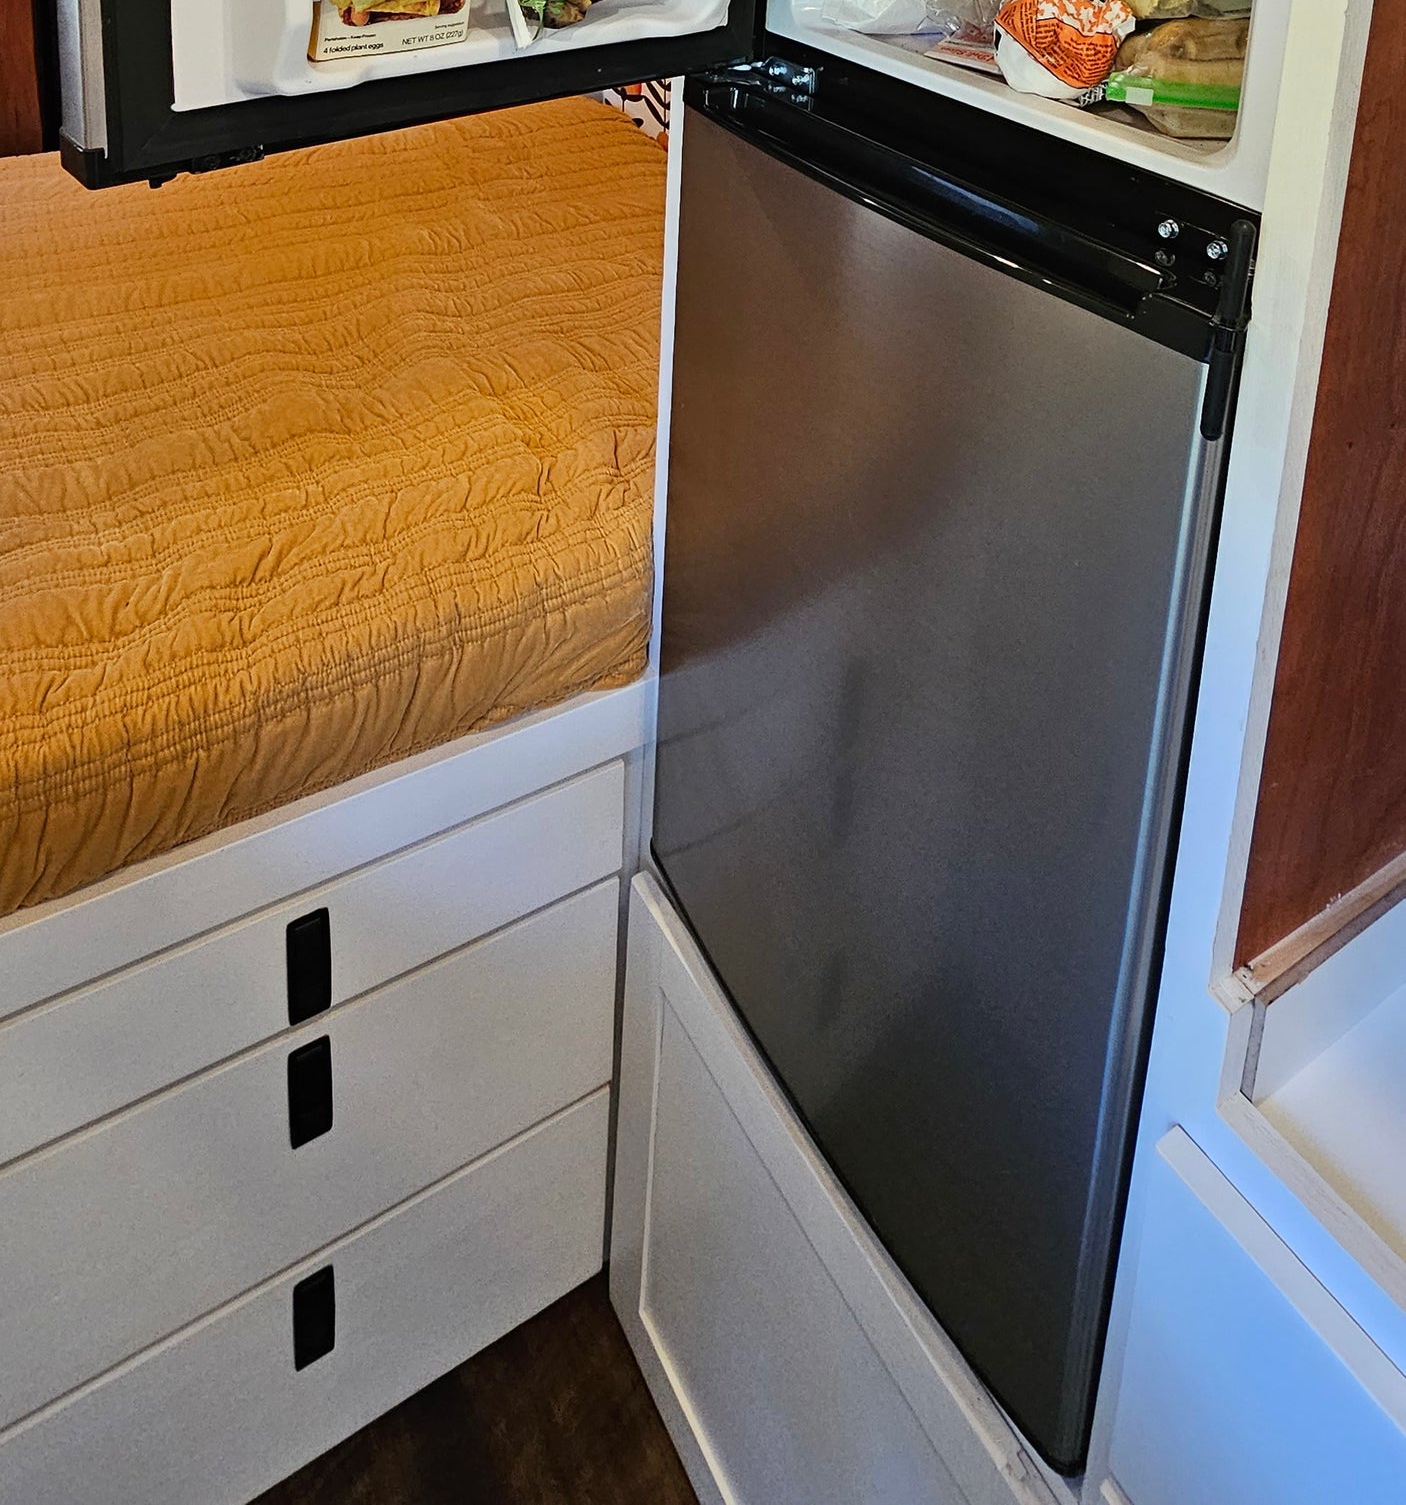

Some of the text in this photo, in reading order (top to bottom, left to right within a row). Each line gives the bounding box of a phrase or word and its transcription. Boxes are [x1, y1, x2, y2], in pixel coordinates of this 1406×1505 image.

[401, 36, 417, 46] NET
[417, 35, 429, 43] WT
[434, 32, 445, 41] OZ
[328, 45, 351, 53] folded
[350, 44, 367, 53] plant
[367, 43, 384, 51] eggs
